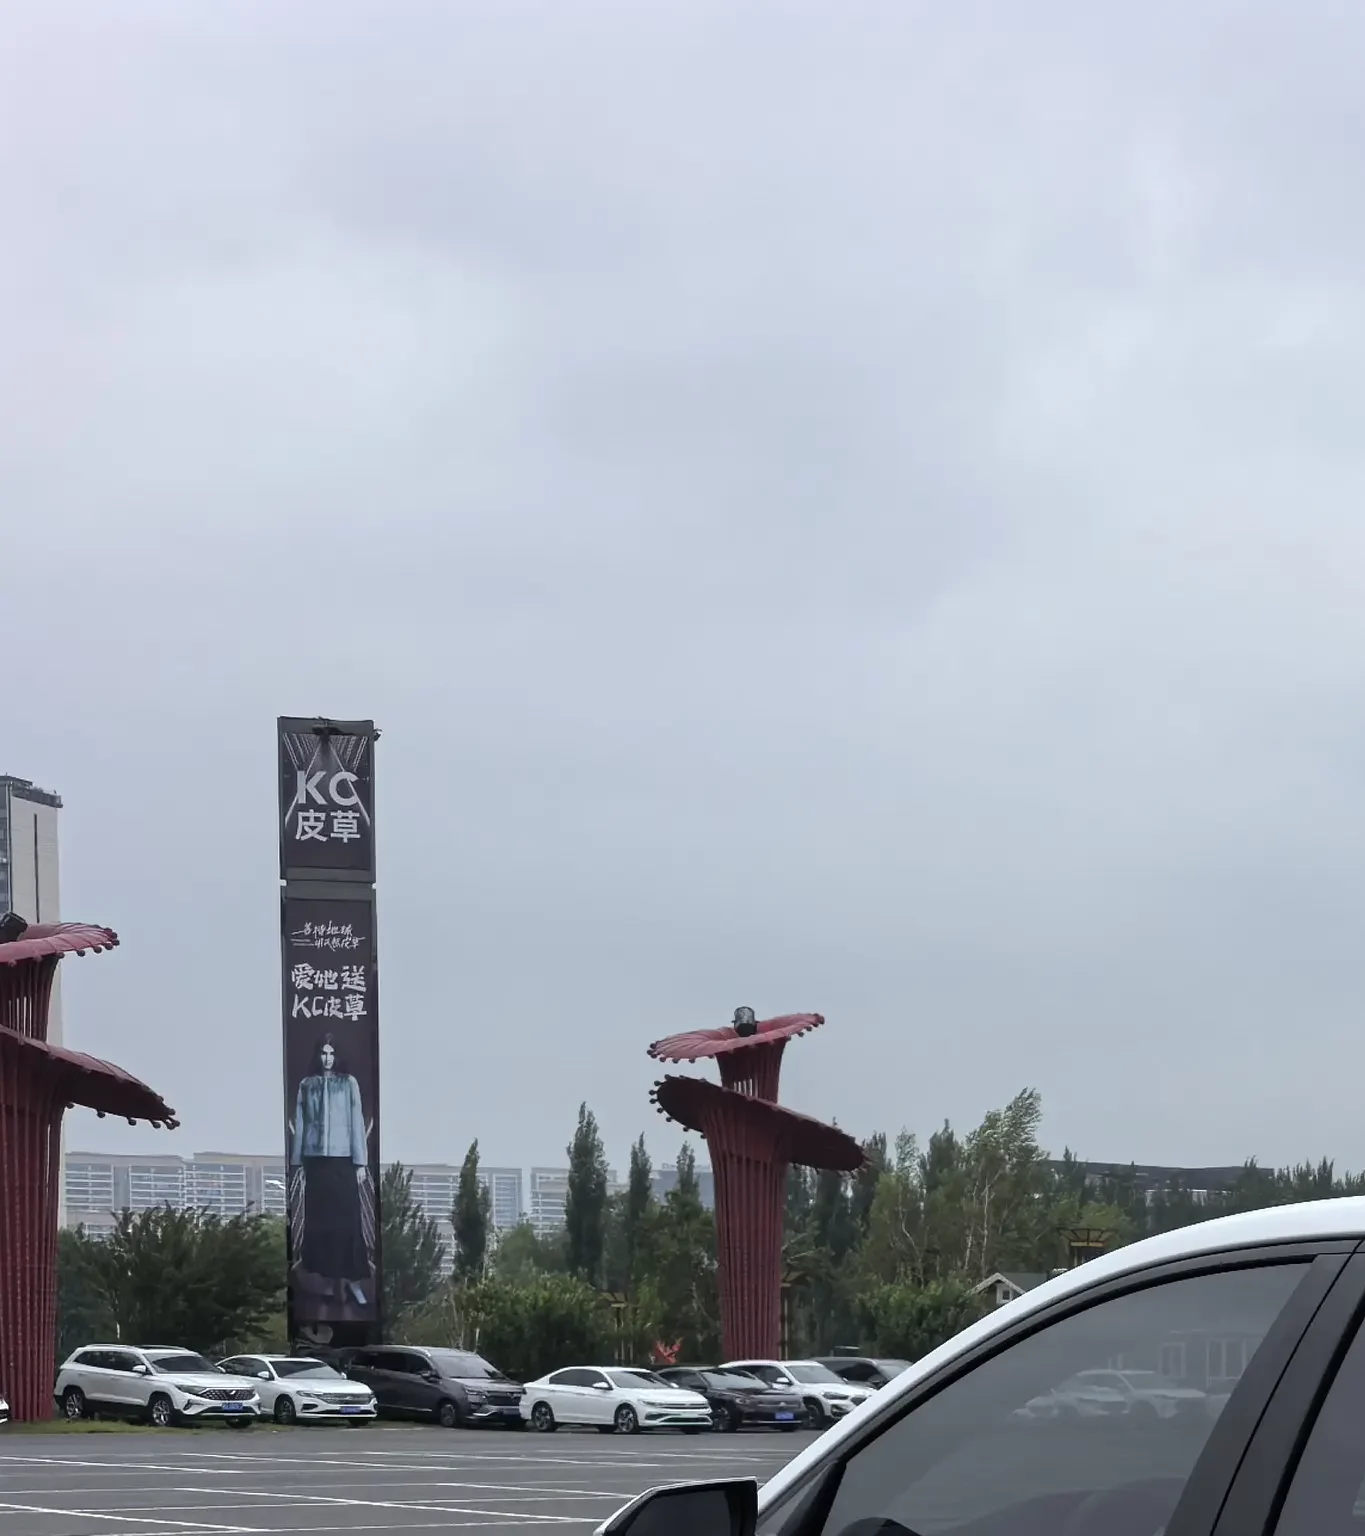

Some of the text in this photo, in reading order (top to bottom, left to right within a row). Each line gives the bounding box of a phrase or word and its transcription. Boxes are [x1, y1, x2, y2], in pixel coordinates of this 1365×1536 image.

[296, 770, 359, 807] KC
[295, 808, 361, 844] 皮草
[290, 962, 367, 992] 爱她送
[291, 993, 368, 1021] KC皮草
